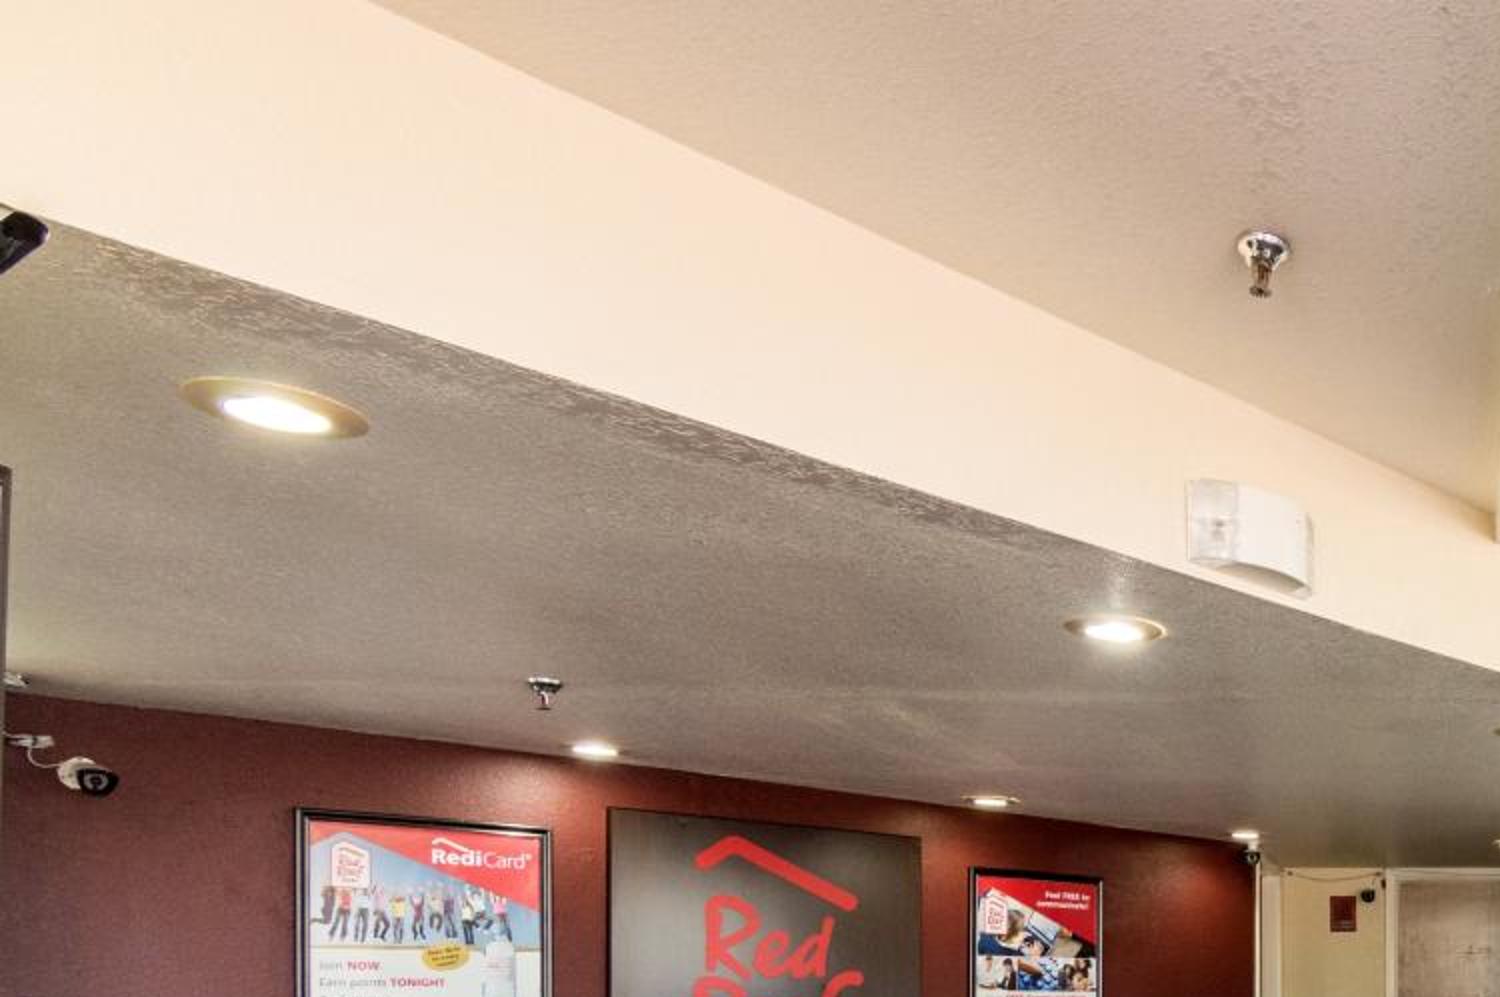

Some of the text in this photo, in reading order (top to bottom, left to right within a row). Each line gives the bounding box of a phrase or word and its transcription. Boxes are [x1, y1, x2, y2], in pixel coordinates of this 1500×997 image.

[704, 894, 836, 980] Red
[347, 960, 381, 972] NOW
[389, 976, 445, 988] TONIGHT
